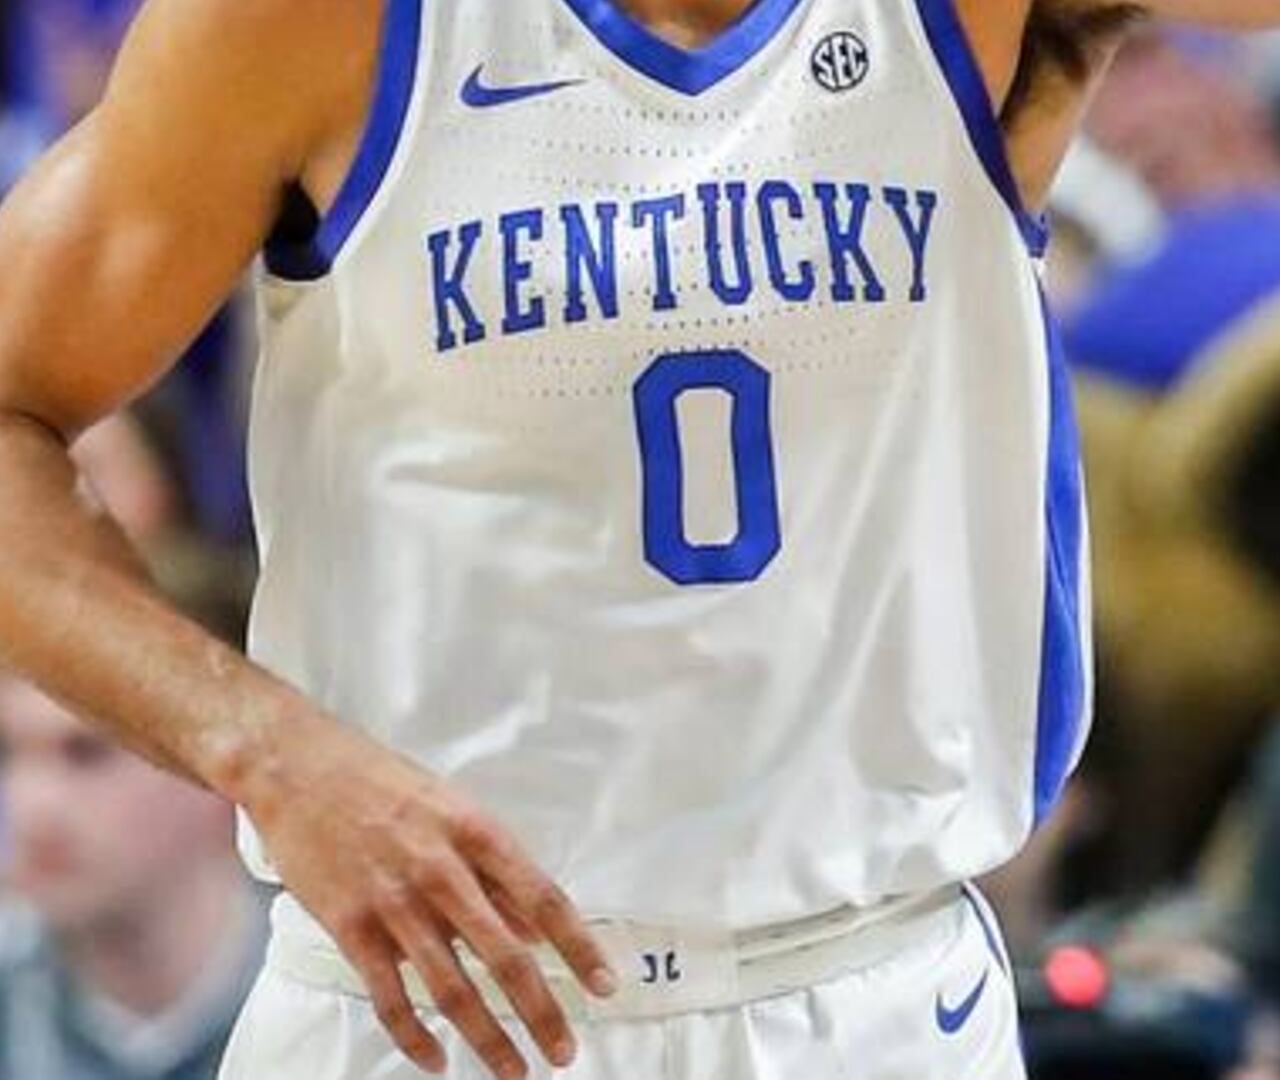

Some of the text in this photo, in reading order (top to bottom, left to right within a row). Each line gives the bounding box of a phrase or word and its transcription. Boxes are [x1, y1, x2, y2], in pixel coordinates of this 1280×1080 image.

[812, 33, 868, 90] SEC
[427, 179, 936, 353] KENTUCKY
[633, 349, 782, 587] 0
